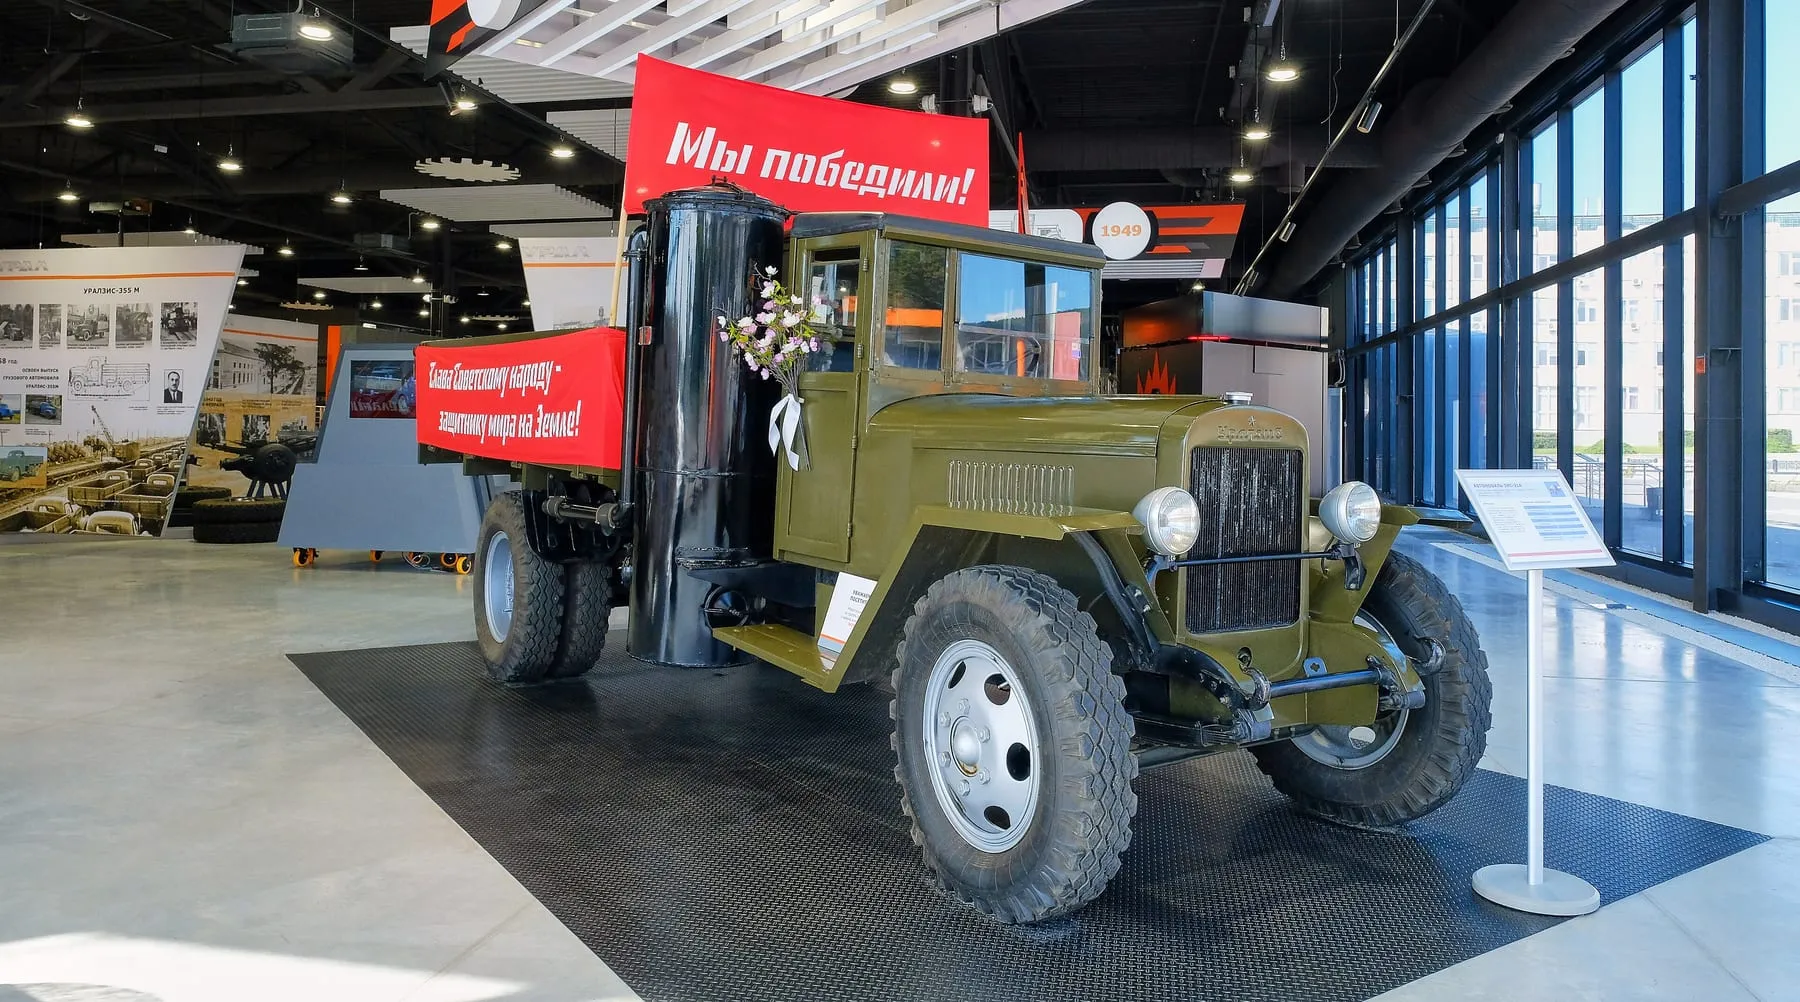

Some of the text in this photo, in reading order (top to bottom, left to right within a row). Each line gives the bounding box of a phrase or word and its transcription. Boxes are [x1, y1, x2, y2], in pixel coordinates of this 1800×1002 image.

[666, 121, 975, 205] Мы победили!
[1101, 224, 1142, 237] 1949
[83, 287, 132, 295] УРАЛЗИС-355
[429, 361, 452, 389] Слава
[453, 363, 510, 398] Советскому
[509, 361, 554, 396] народу
[438, 400, 581, 446] защитнику мира на Земле!
